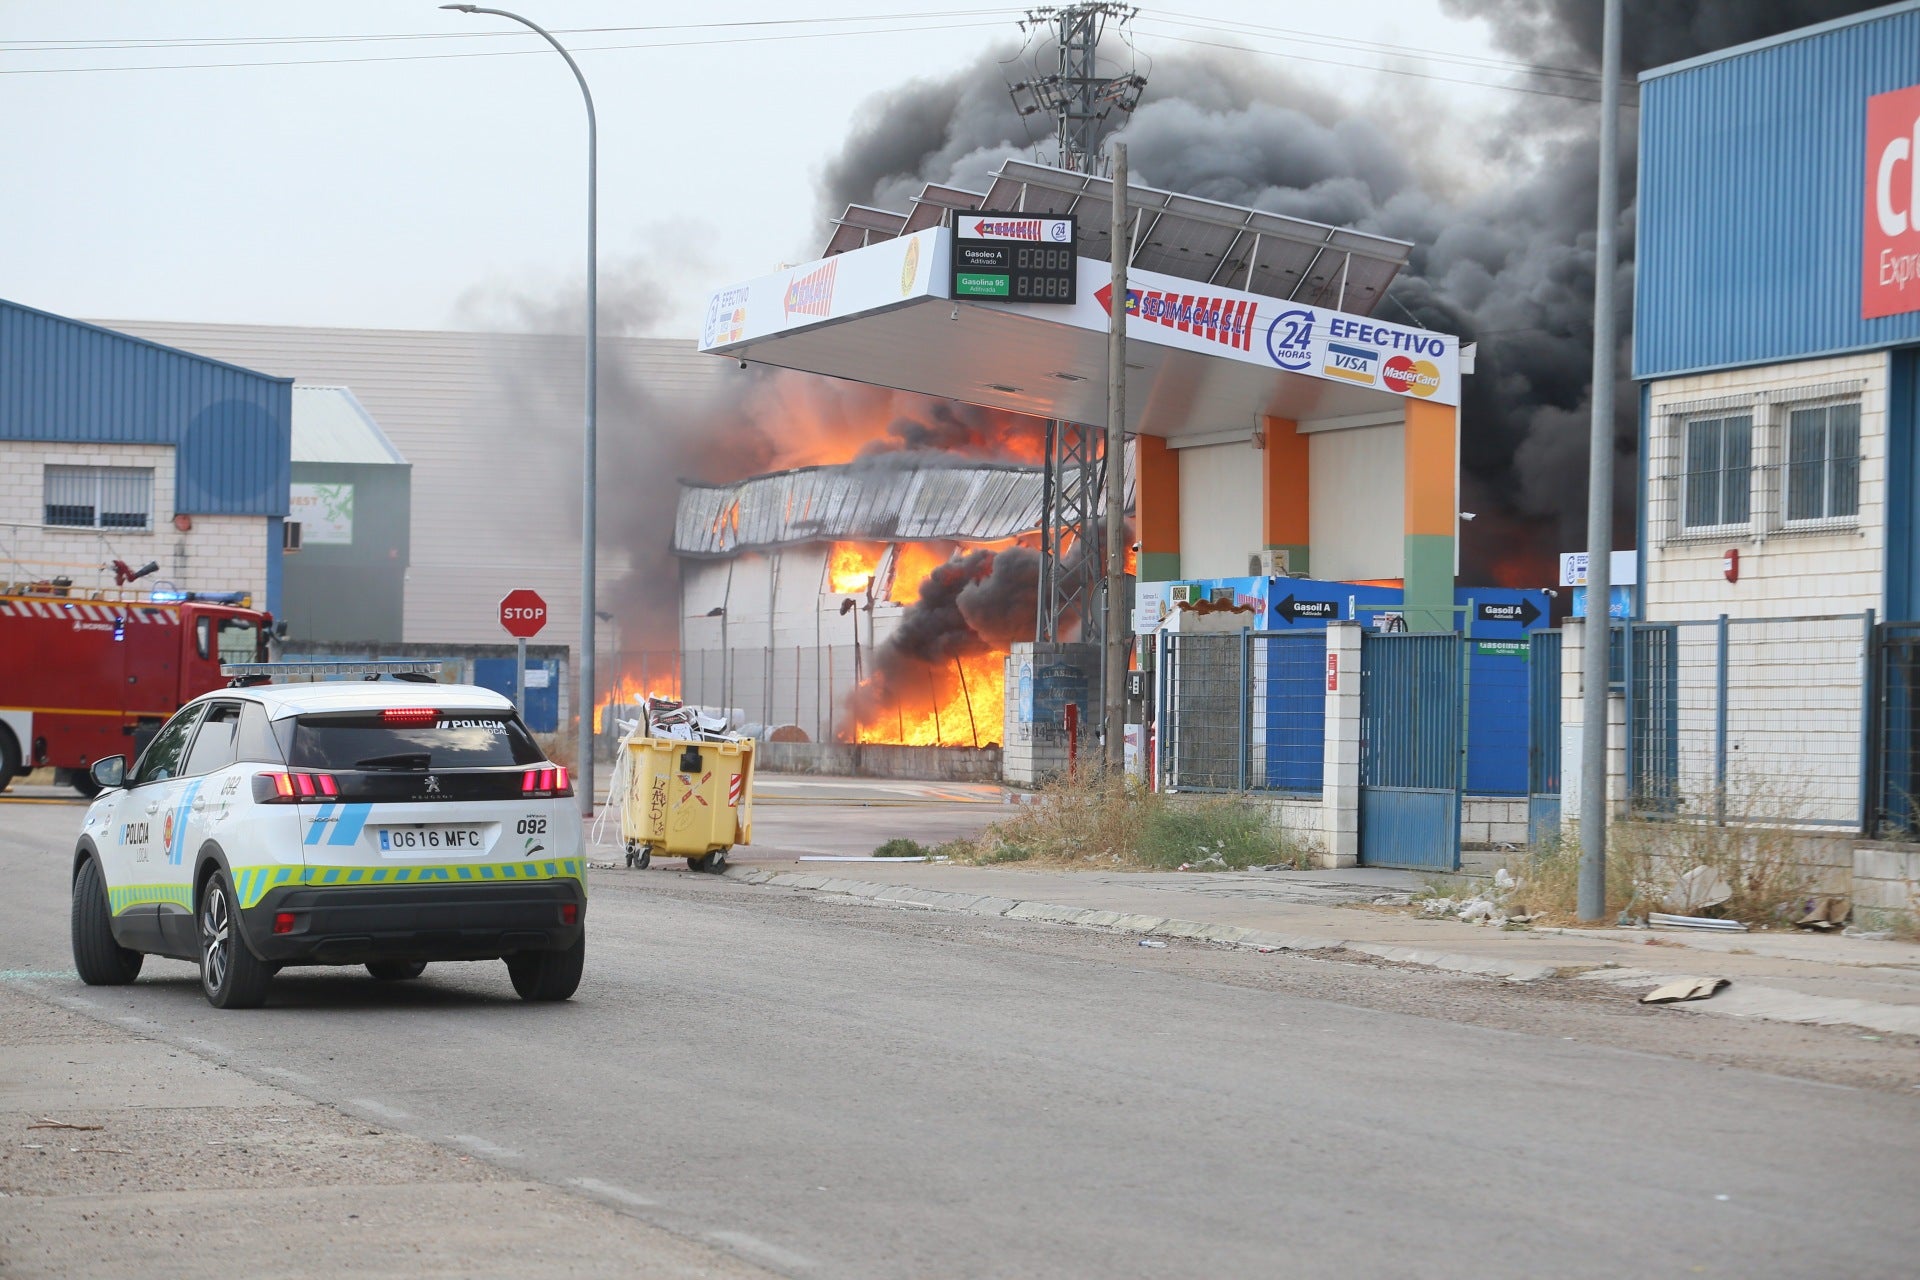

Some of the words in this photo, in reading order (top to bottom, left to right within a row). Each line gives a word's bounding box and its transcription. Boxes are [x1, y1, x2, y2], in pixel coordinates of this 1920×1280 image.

[965, 250, 994, 259] Gasoleo
[996, 251, 1003, 259] A
[961, 278, 994, 287] Gasolina
[995, 279, 1004, 287] 95
[1279, 321, 1313, 350] 24
[1330, 318, 1445, 357] EFECTIVO
[1278, 350, 1312, 360] HORAS
[1335, 354, 1368, 372] VISA
[1384, 366, 1439, 387] MasterCard
[1293, 603, 1322, 612] Gasoil
[1323, 603, 1331, 612] A
[1485, 606, 1514, 614] Gasoil
[504, 608, 544, 619] STOP
[451, 720, 506, 729] POLICIA
[482, 728, 510, 736] LOCAL
[516, 819, 547, 835] 092
[125, 822, 149, 845] POLICIA
[393, 831, 440, 848] 0616
[445, 830, 480, 847] MFC
